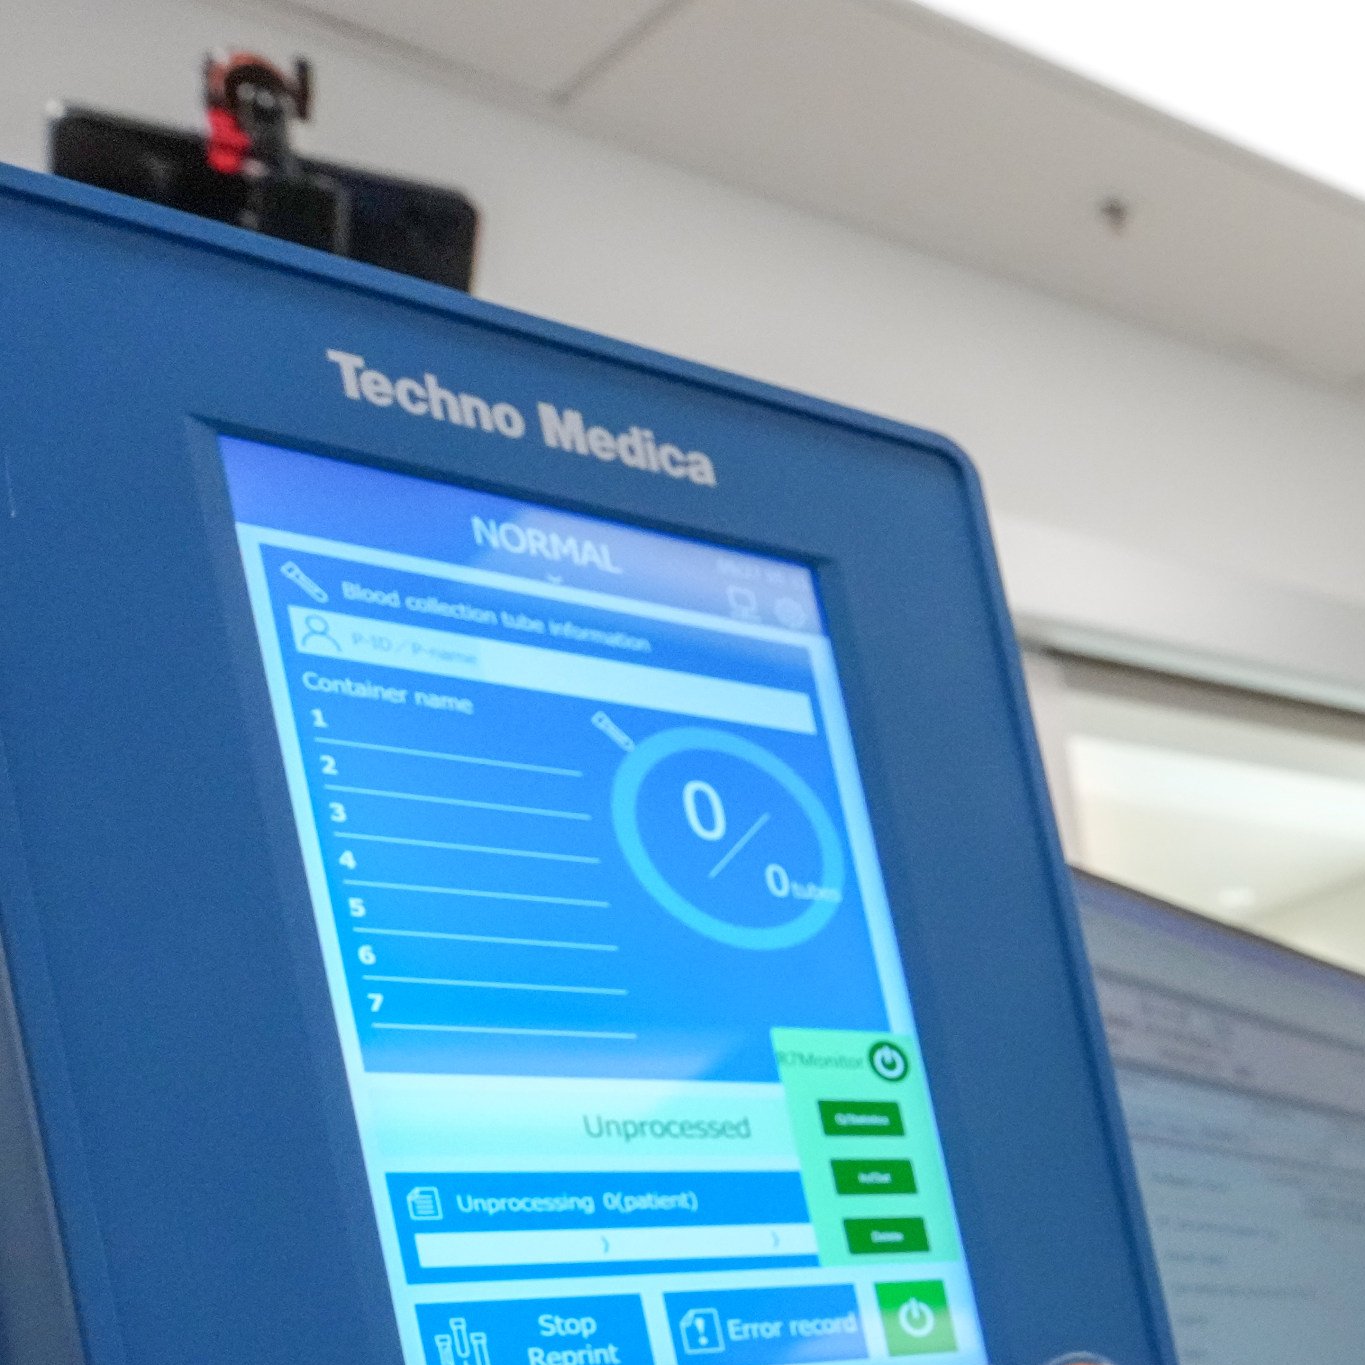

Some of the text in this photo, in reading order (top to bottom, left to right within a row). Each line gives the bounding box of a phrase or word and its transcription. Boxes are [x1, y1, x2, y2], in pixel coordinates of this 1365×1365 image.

[326, 349, 718, 488] Techno Medica
[472, 514, 622, 576] NORMAL
[341, 580, 652, 652] Blood collection tube information
[301, 670, 474, 715] Container name
[311, 708, 328, 728] 1
[319, 755, 338, 775] 2
[329, 802, 347, 824] 3
[684, 779, 728, 842] 0
[338, 849, 356, 870] 4
[763, 861, 790, 899] 0
[349, 896, 367, 918] 5
[359, 944, 376, 966] 6
[366, 993, 384, 1013] 7
[582, 1112, 751, 1143] Unprocessed
[456, 1189, 699, 1217] Unprocessing 0(patient)
[537, 1312, 597, 1342] Stop
[727, 1311, 858, 1344] Error record
